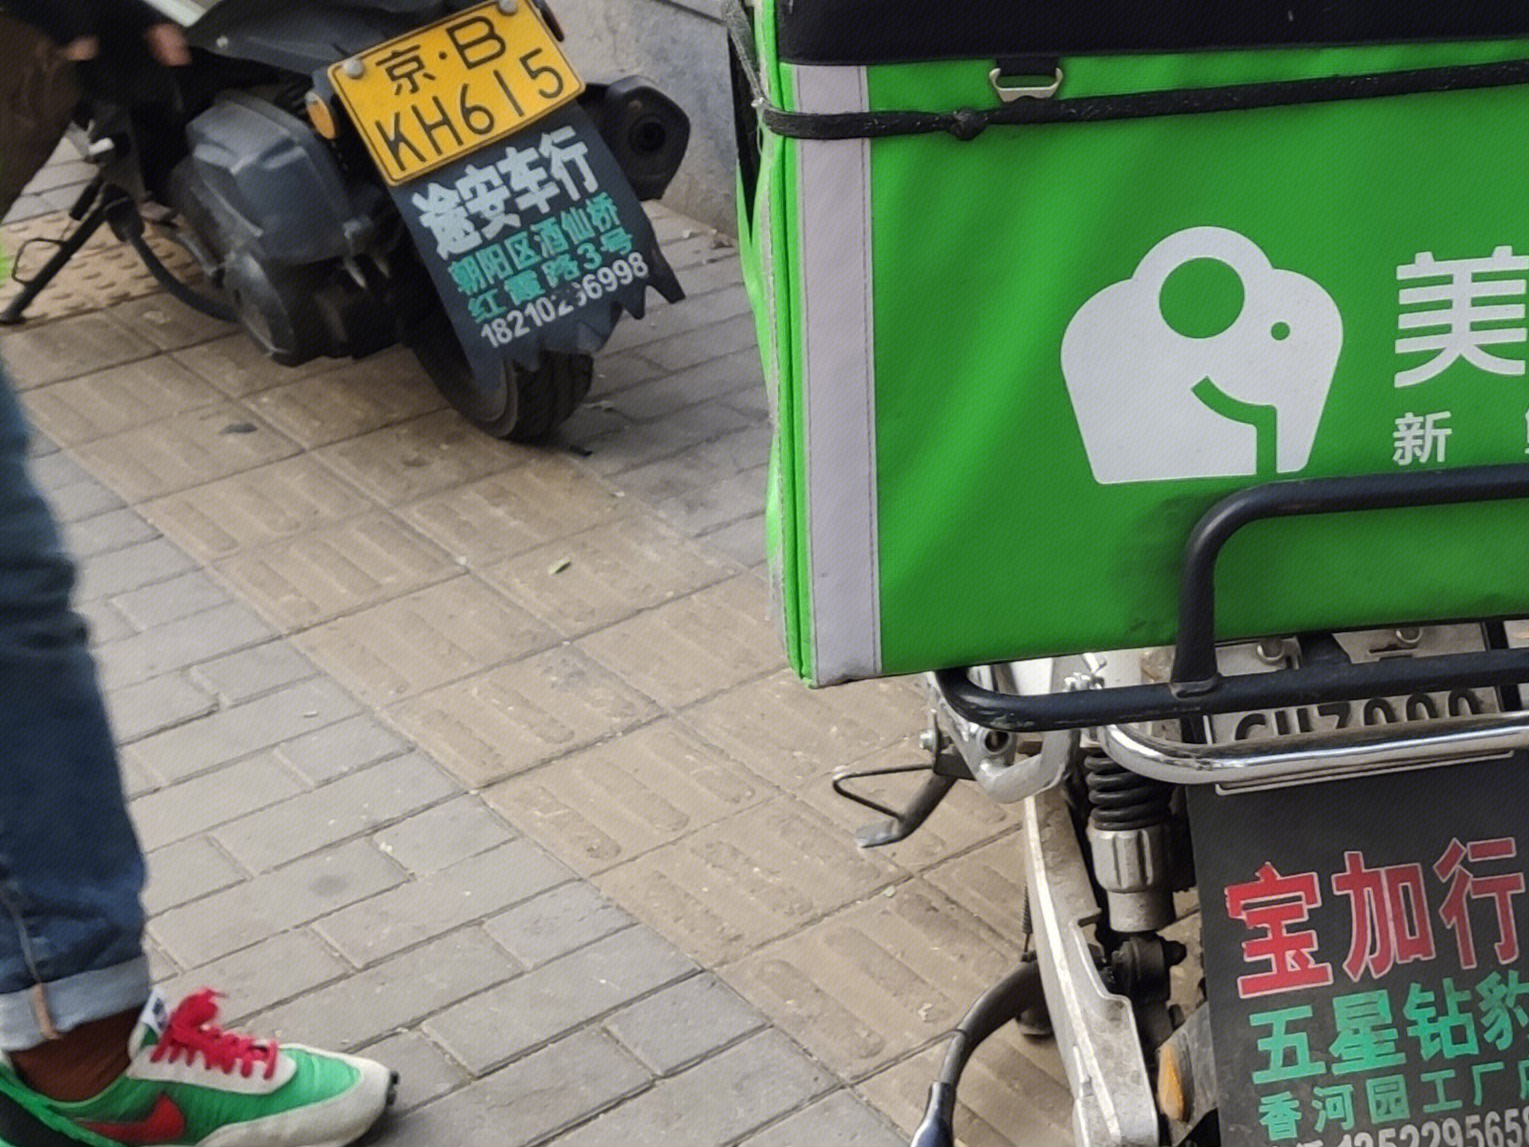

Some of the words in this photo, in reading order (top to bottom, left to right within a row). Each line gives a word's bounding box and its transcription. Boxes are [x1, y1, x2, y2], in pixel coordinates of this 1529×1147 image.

[374, 48, 564, 171] KH615
[411, 126, 599, 260] 途安车行
[447, 192, 621, 296] 朝阳区酒仙桥
[1224, 838, 1525, 999] 宝加行
